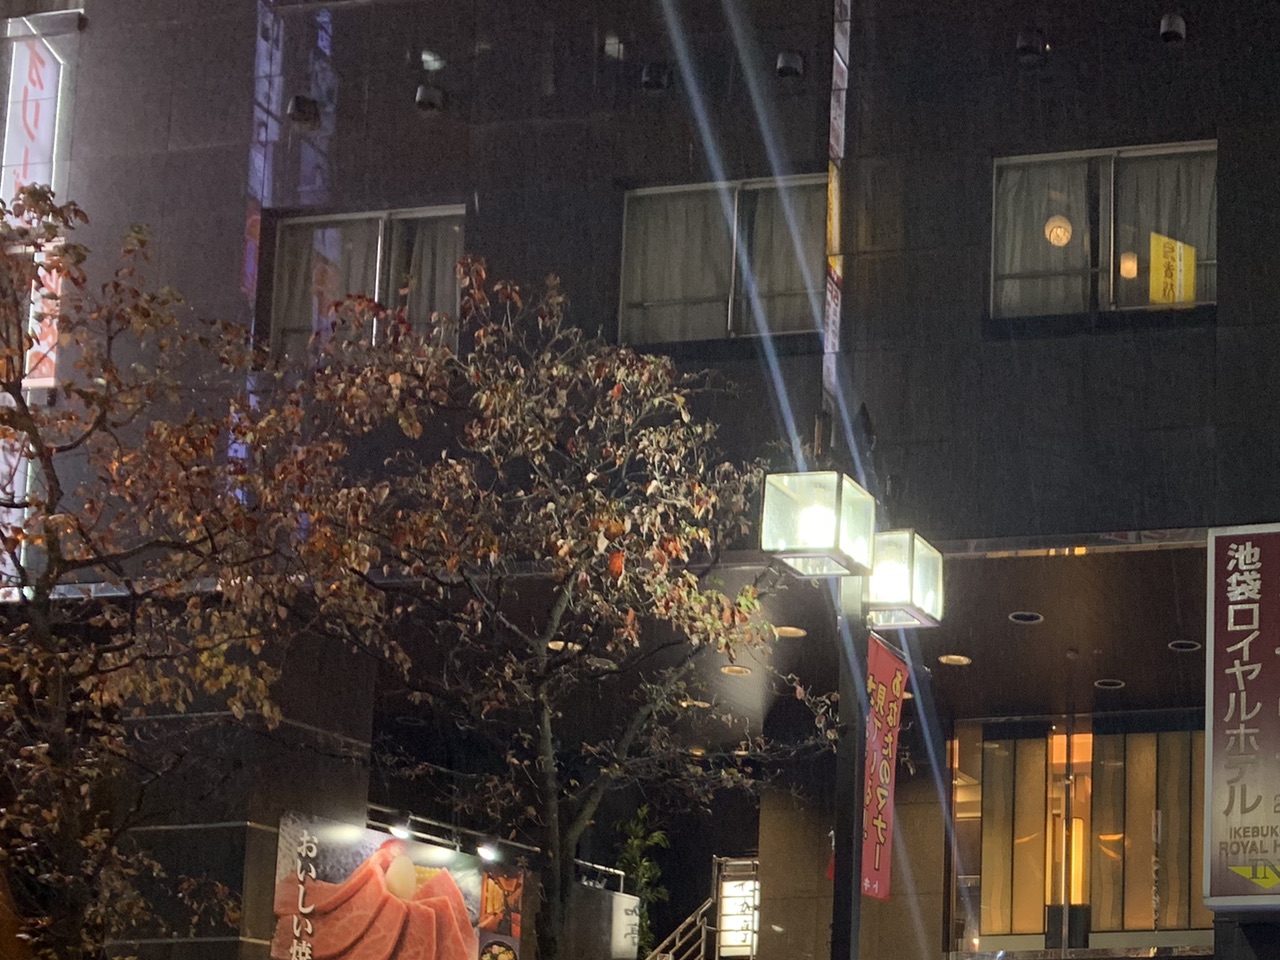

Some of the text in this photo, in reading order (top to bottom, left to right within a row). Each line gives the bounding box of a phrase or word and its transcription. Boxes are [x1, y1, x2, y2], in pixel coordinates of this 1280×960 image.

[1223, 541, 1262, 817] 池袋ロイヤルホテル
[1219, 839, 1268, 856] ROYAL
